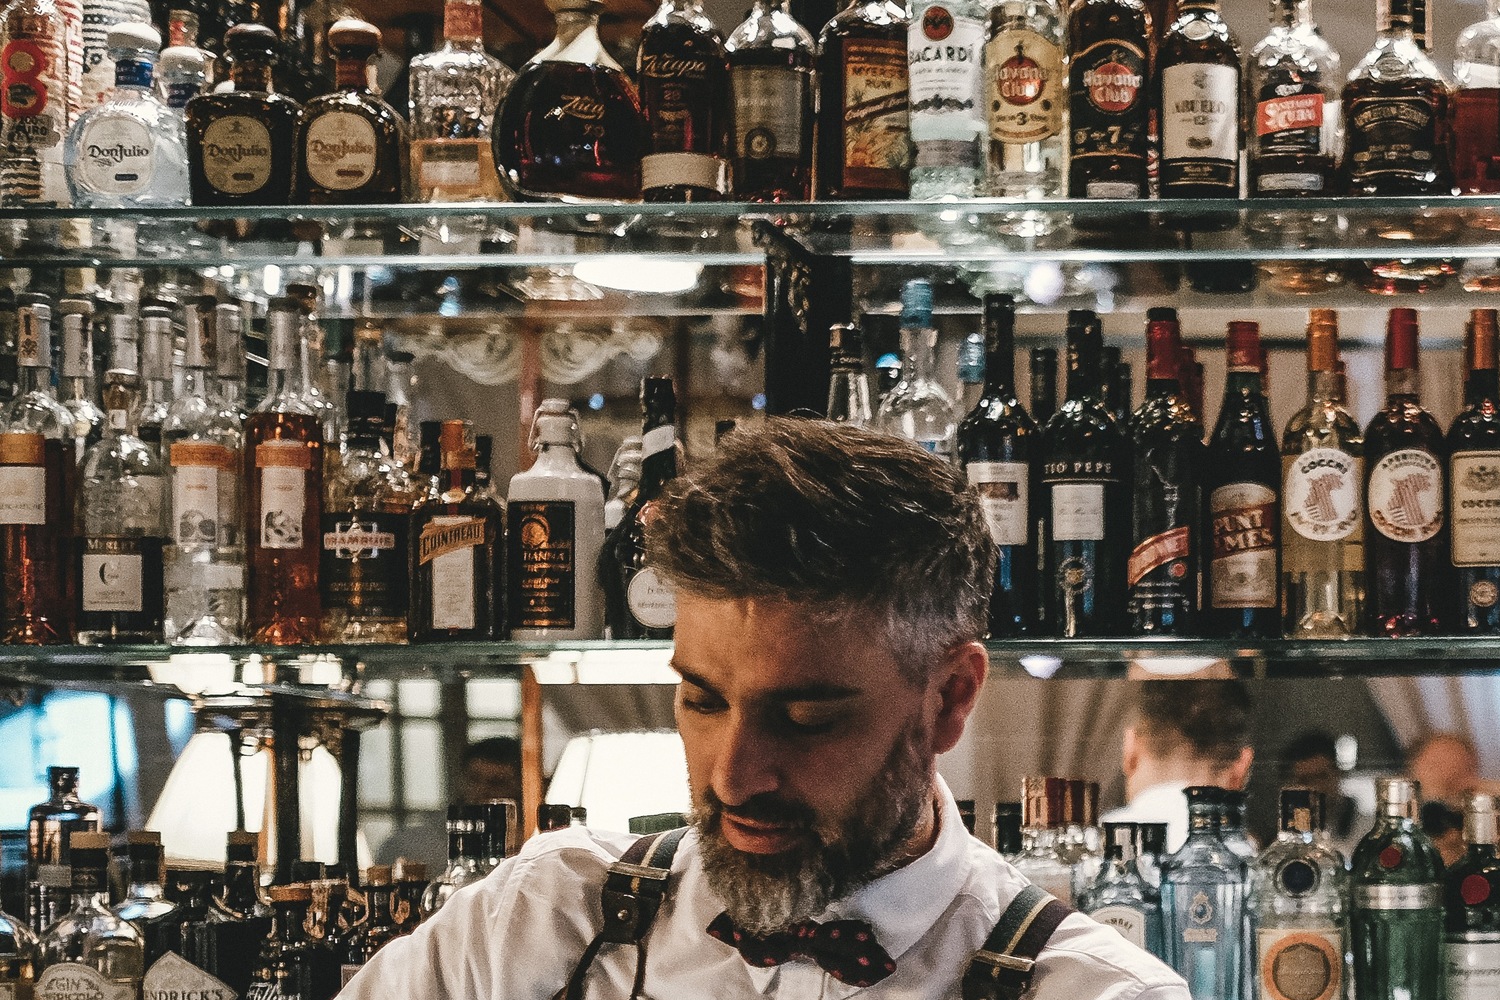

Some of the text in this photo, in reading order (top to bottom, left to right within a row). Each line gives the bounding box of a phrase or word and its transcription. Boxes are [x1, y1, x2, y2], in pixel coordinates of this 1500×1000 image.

[1094, 87, 1133, 102] Club
[1016, 111, 1027, 126] 3
[1107, 125, 1121, 144] 7
[1073, 461, 1112, 474] PEPE
[423, 524, 481, 556] COINTREAU
[55, 979, 80, 991] GIN
